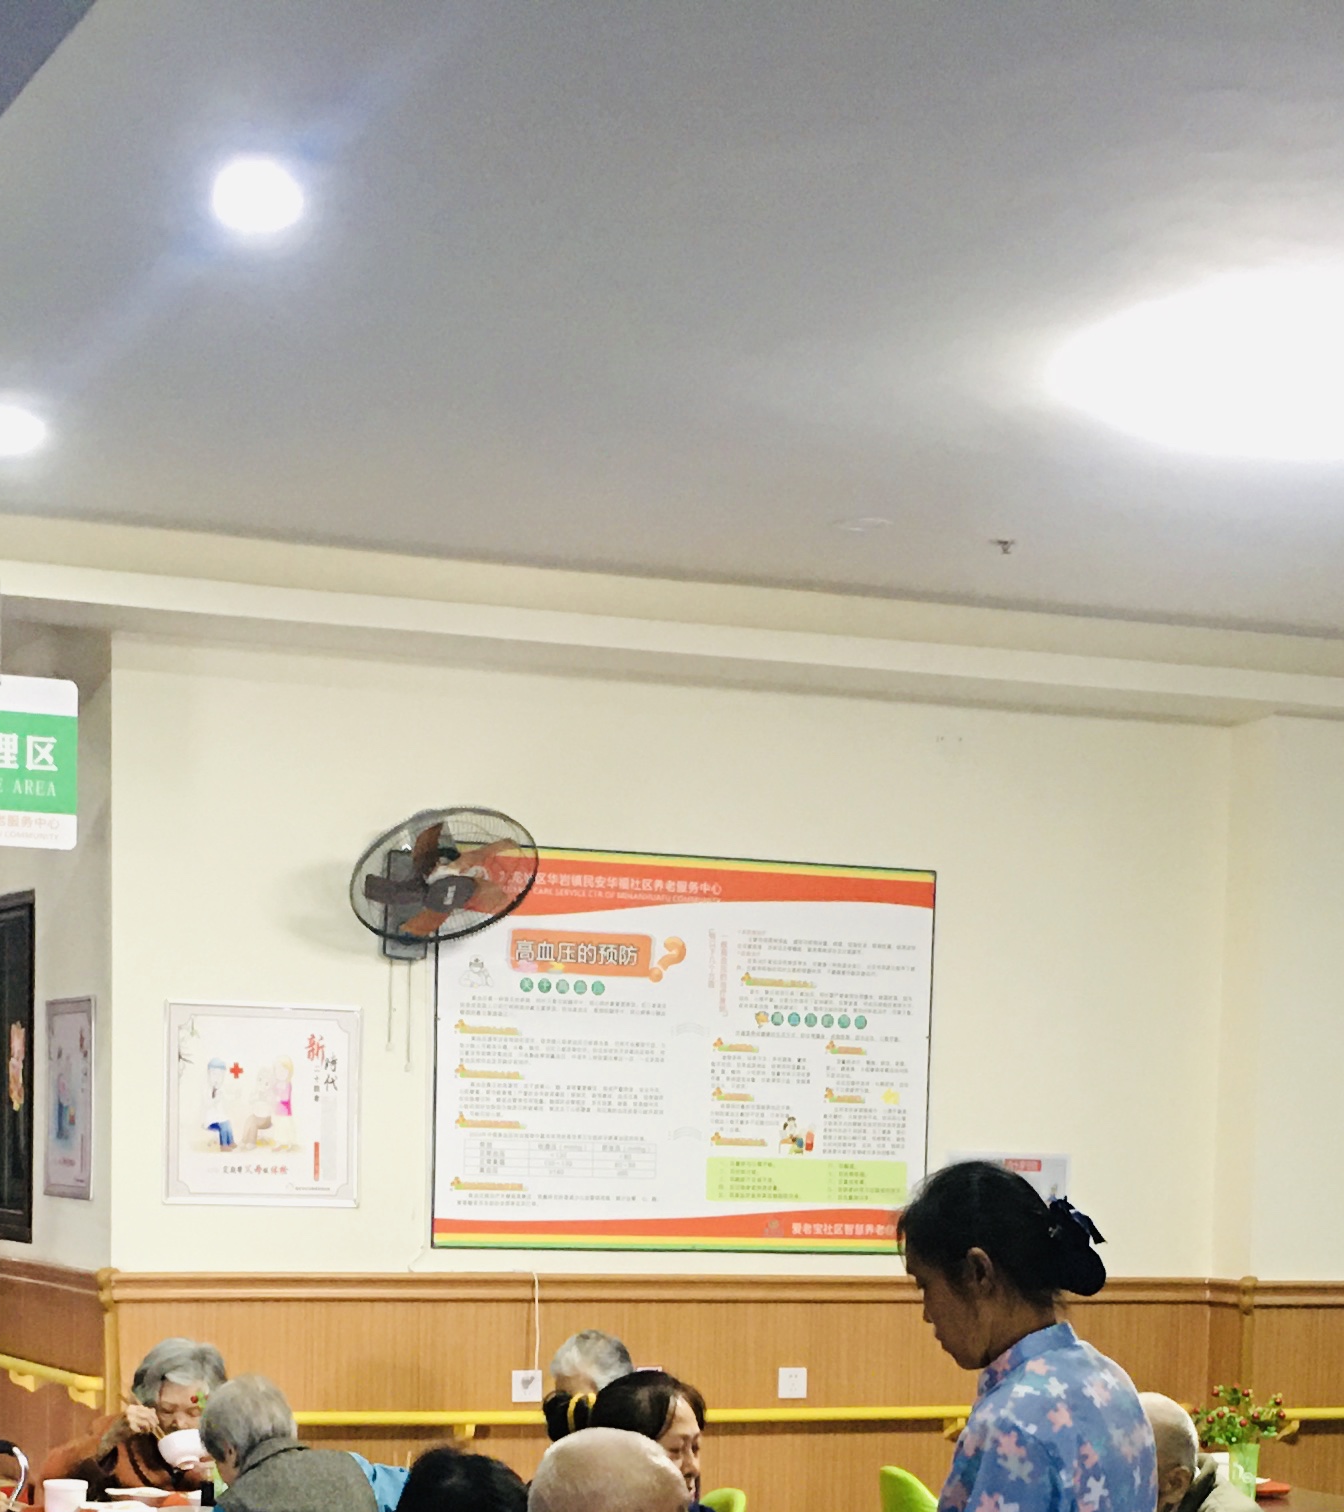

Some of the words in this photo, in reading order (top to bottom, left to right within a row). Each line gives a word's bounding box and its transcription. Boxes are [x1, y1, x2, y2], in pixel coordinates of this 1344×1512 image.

[13, 779, 57, 797] AREA
[514, 939, 639, 966] 高血压的预防
